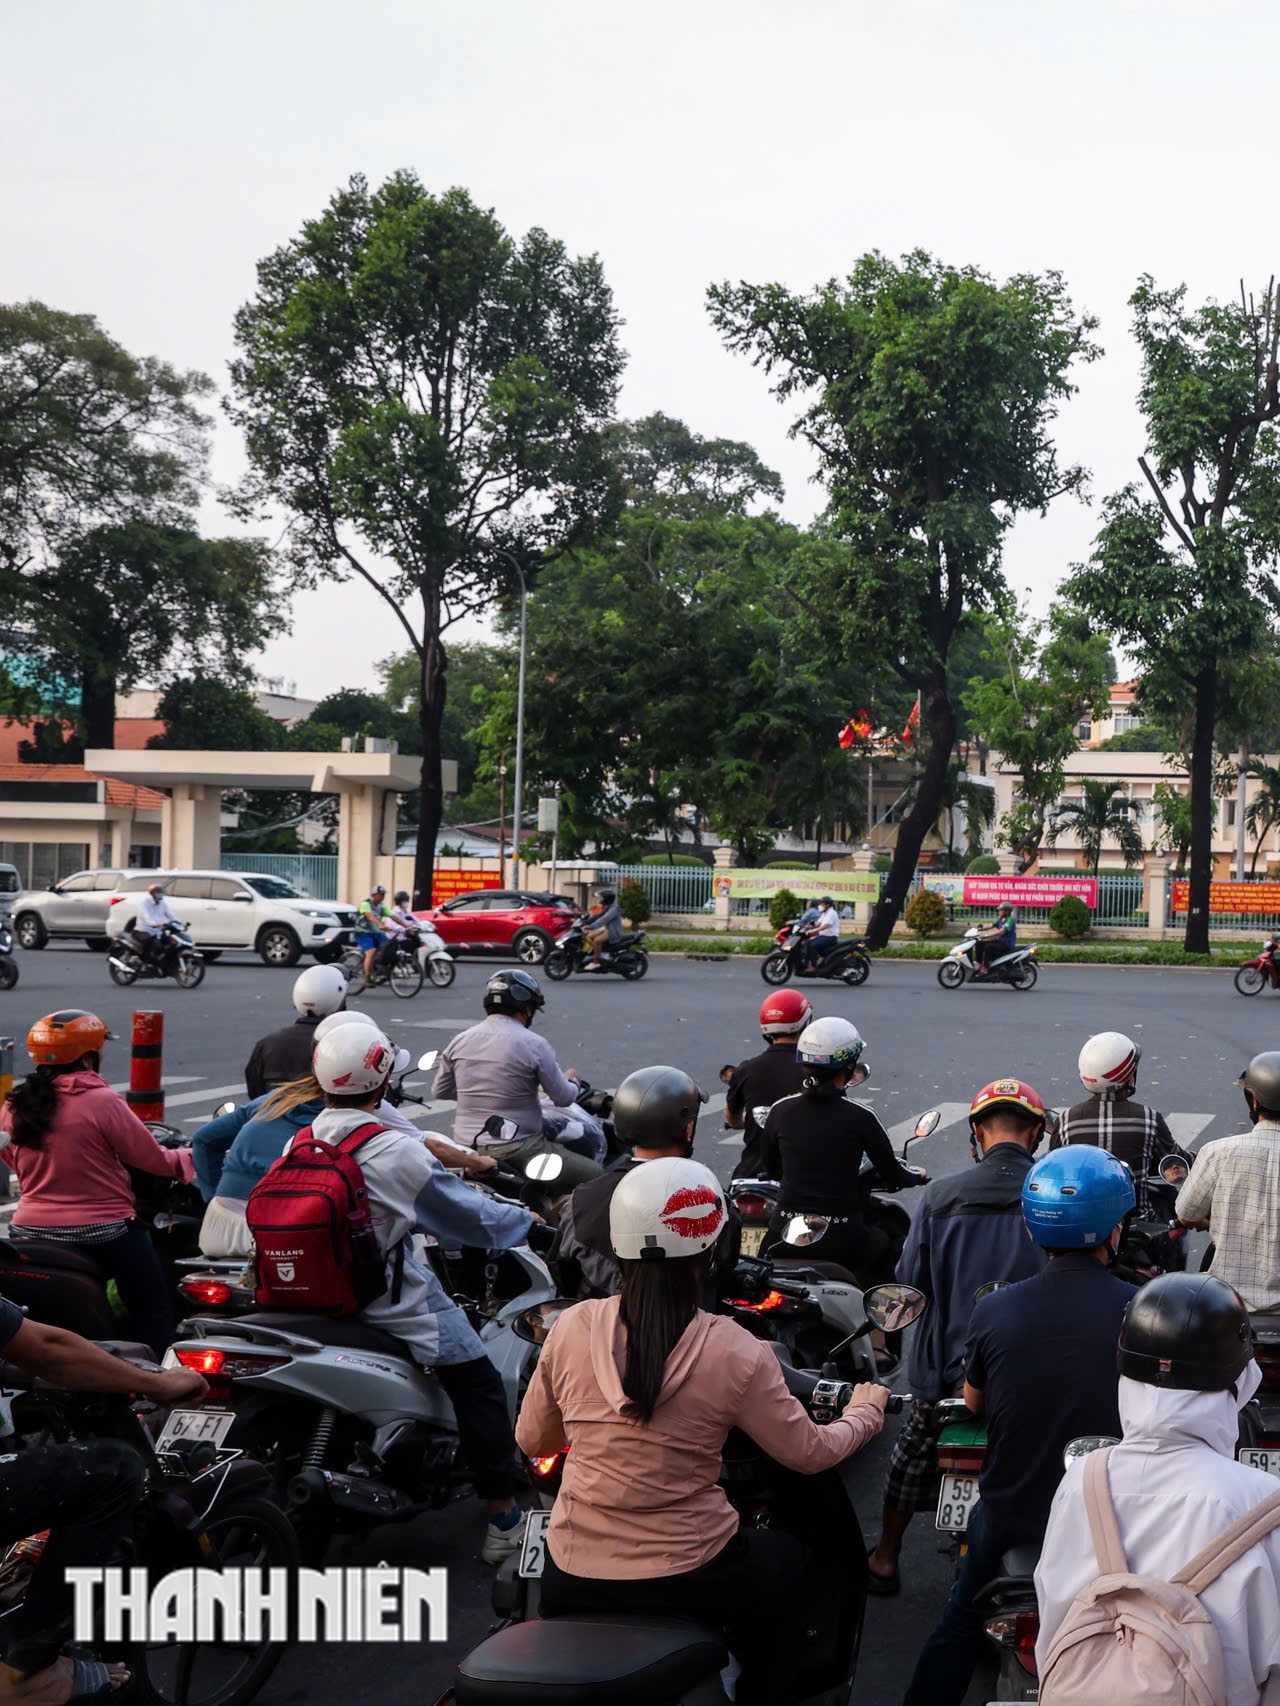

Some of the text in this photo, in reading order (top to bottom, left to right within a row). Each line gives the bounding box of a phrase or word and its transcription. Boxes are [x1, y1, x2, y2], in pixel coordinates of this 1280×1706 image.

[172, 1414, 223, 1438] 67-F1
[951, 1478, 980, 1502] 59-
[941, 1503, 966, 1527] 83
